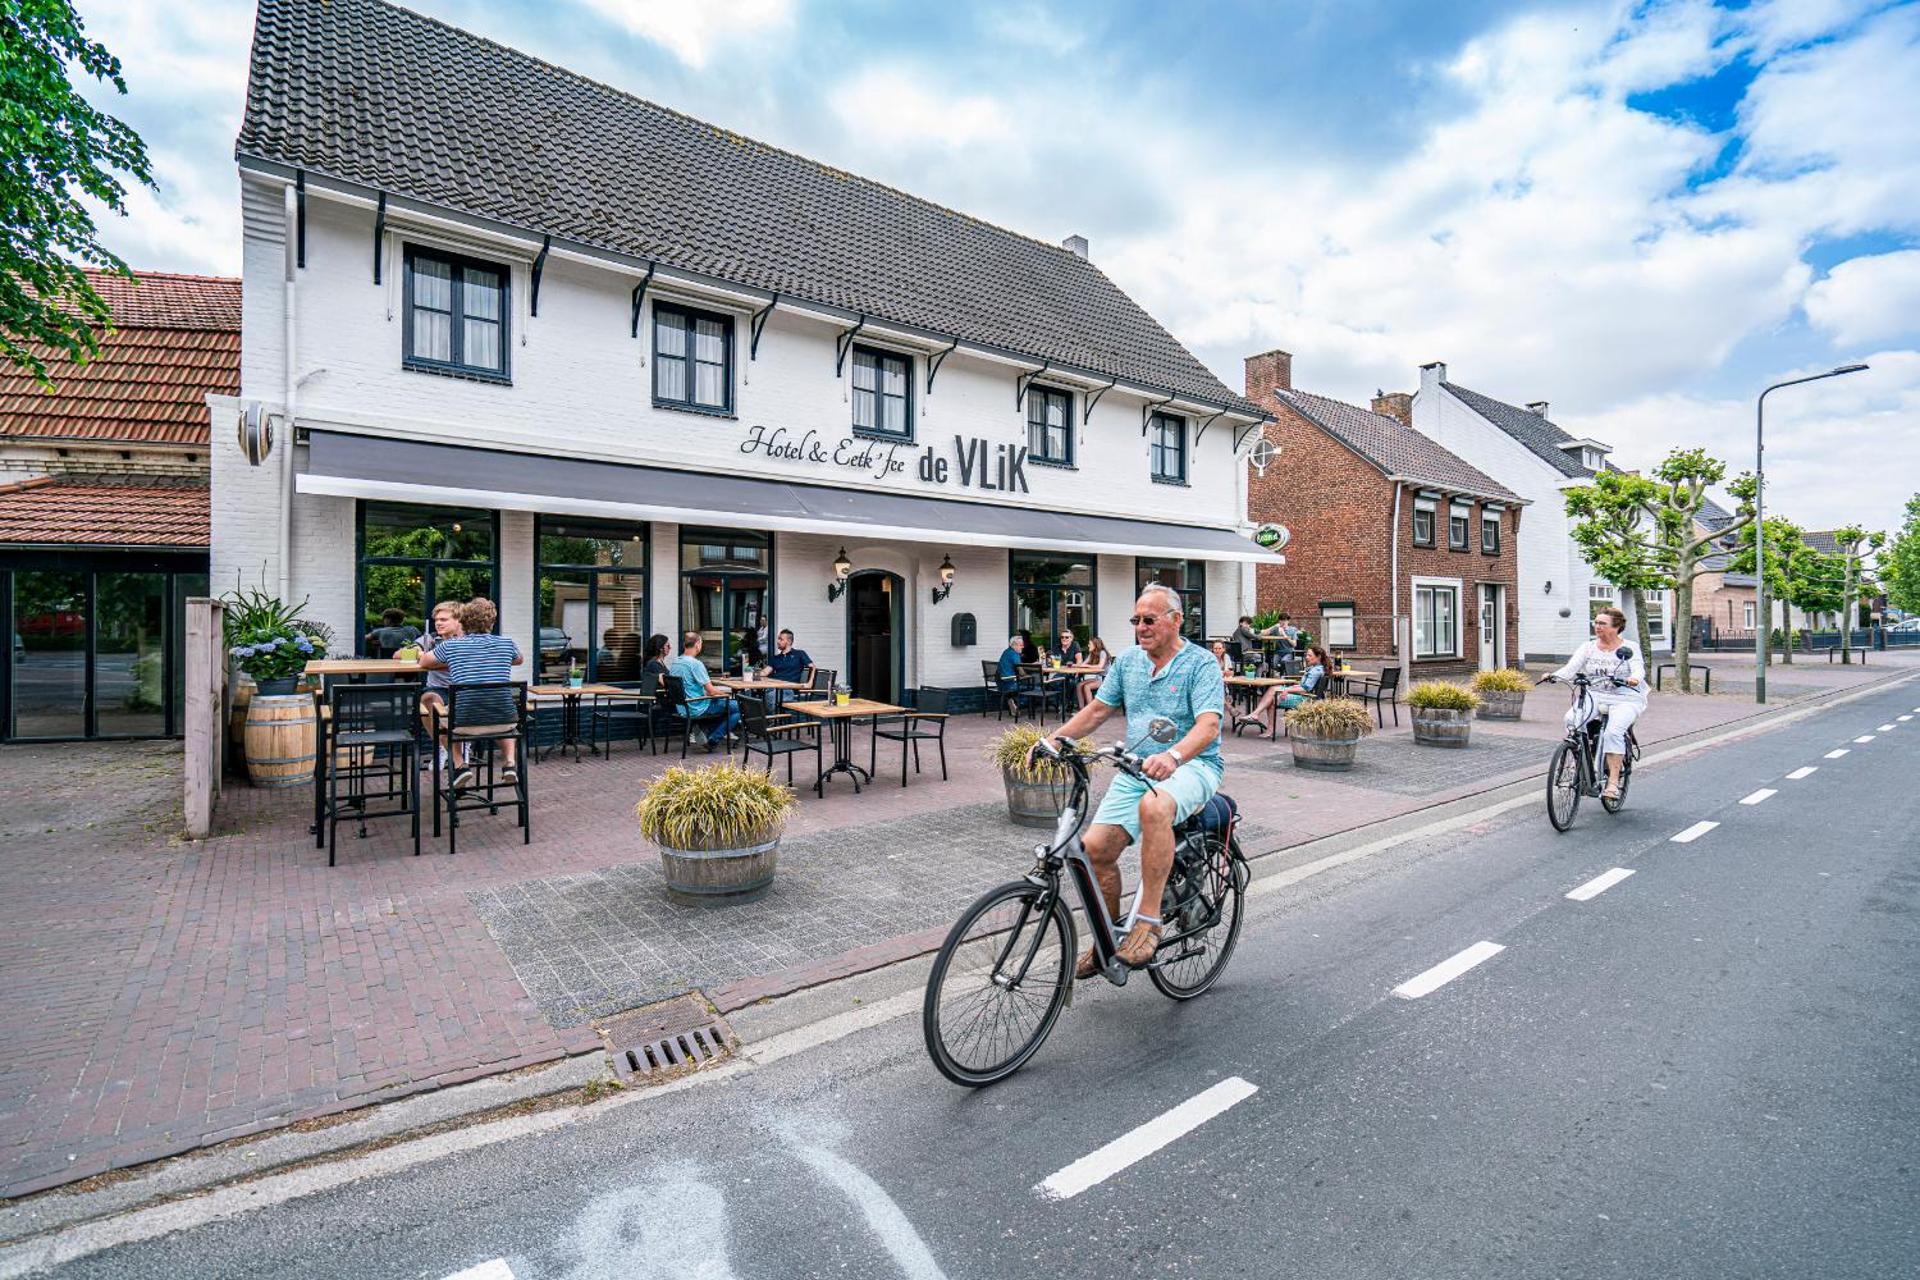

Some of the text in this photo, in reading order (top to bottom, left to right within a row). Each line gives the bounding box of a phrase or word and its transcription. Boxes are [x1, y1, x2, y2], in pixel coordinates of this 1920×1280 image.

[740, 425, 816, 460] Hotel
[808, 441, 828, 463] &
[919, 446, 948, 483] de
[955, 434, 1029, 493] VLiK
